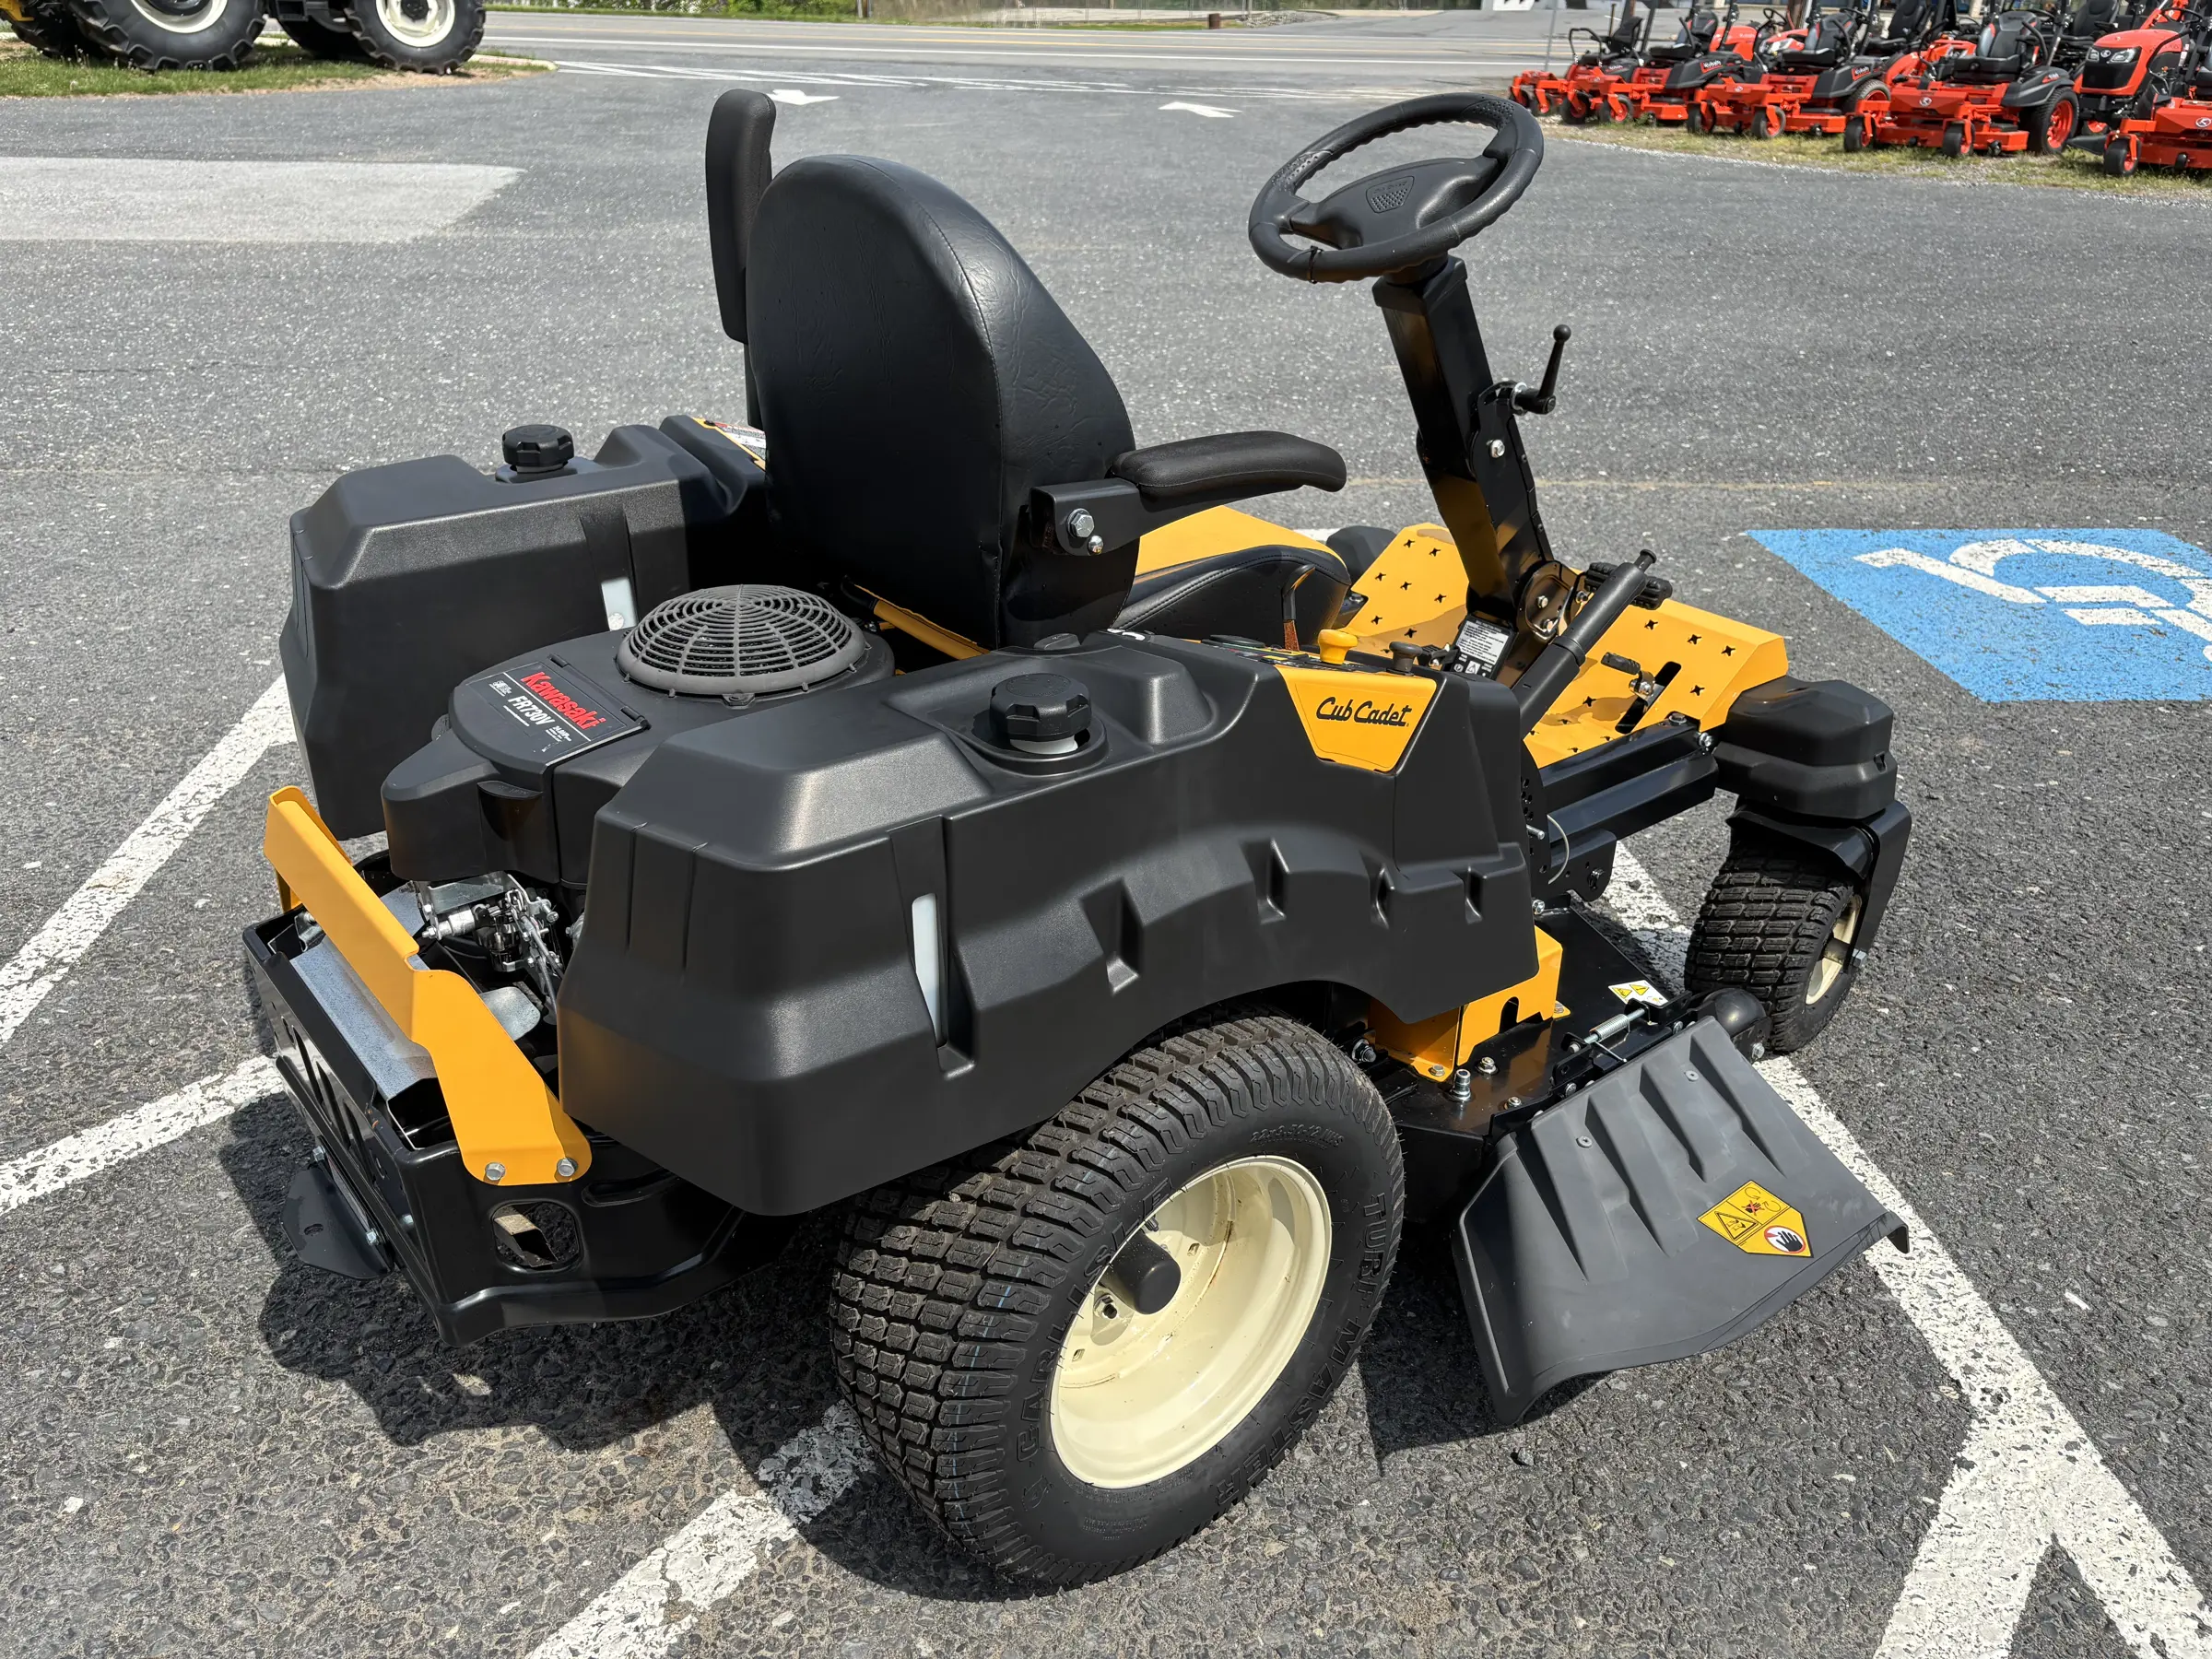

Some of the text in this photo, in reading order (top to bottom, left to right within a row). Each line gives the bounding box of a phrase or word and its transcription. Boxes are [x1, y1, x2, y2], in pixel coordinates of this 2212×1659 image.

[508, 696, 555, 725] FR730V
[521, 671, 606, 730] Kawasaki
[1316, 696, 1412, 727] Cub Cadet
[1216, 1318, 1362, 1506] MASTER
